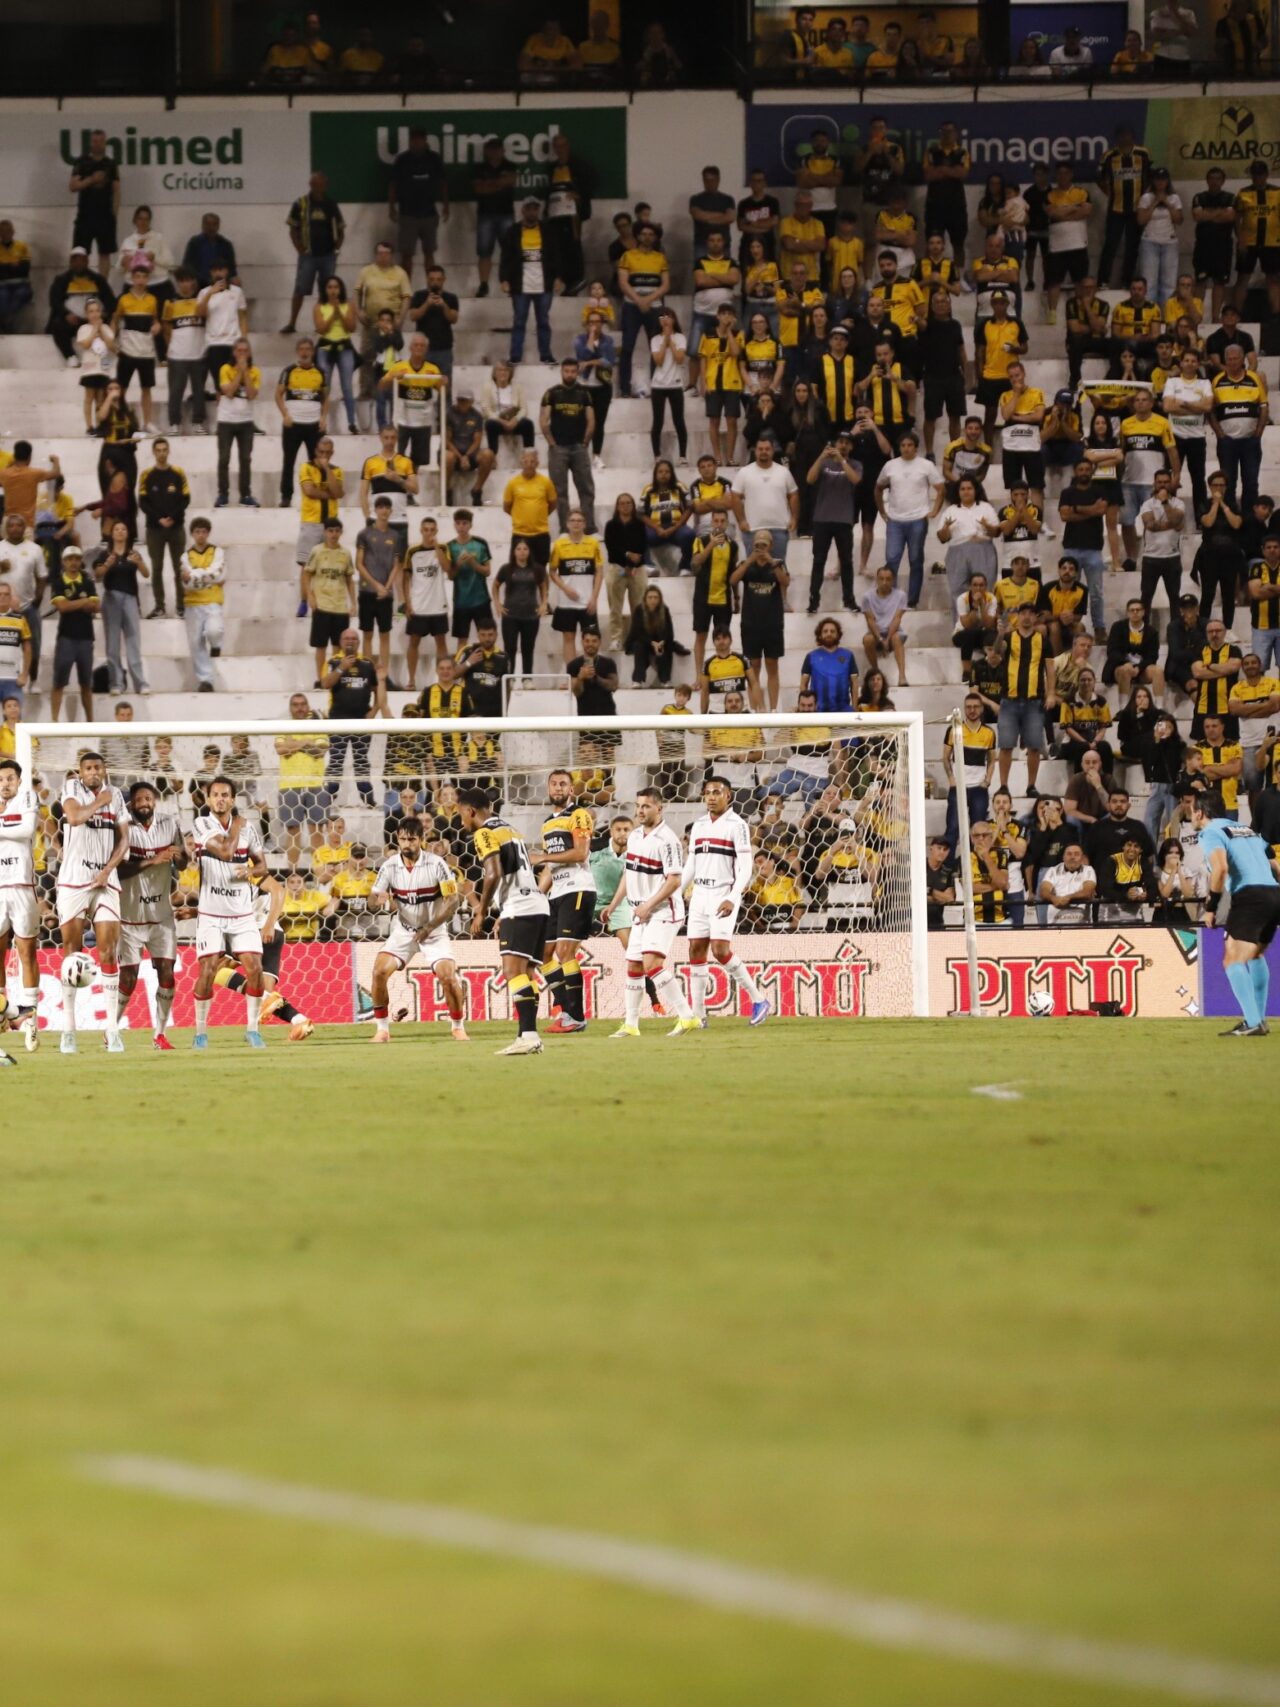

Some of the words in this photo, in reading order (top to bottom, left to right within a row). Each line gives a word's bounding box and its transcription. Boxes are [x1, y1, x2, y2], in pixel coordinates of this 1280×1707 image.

[162, 171, 243, 191] Criciúma
[553, 872, 570, 881] MAQ
[210, 886, 242, 897] NICNET
[946, 935, 1145, 1017] PITÚ
